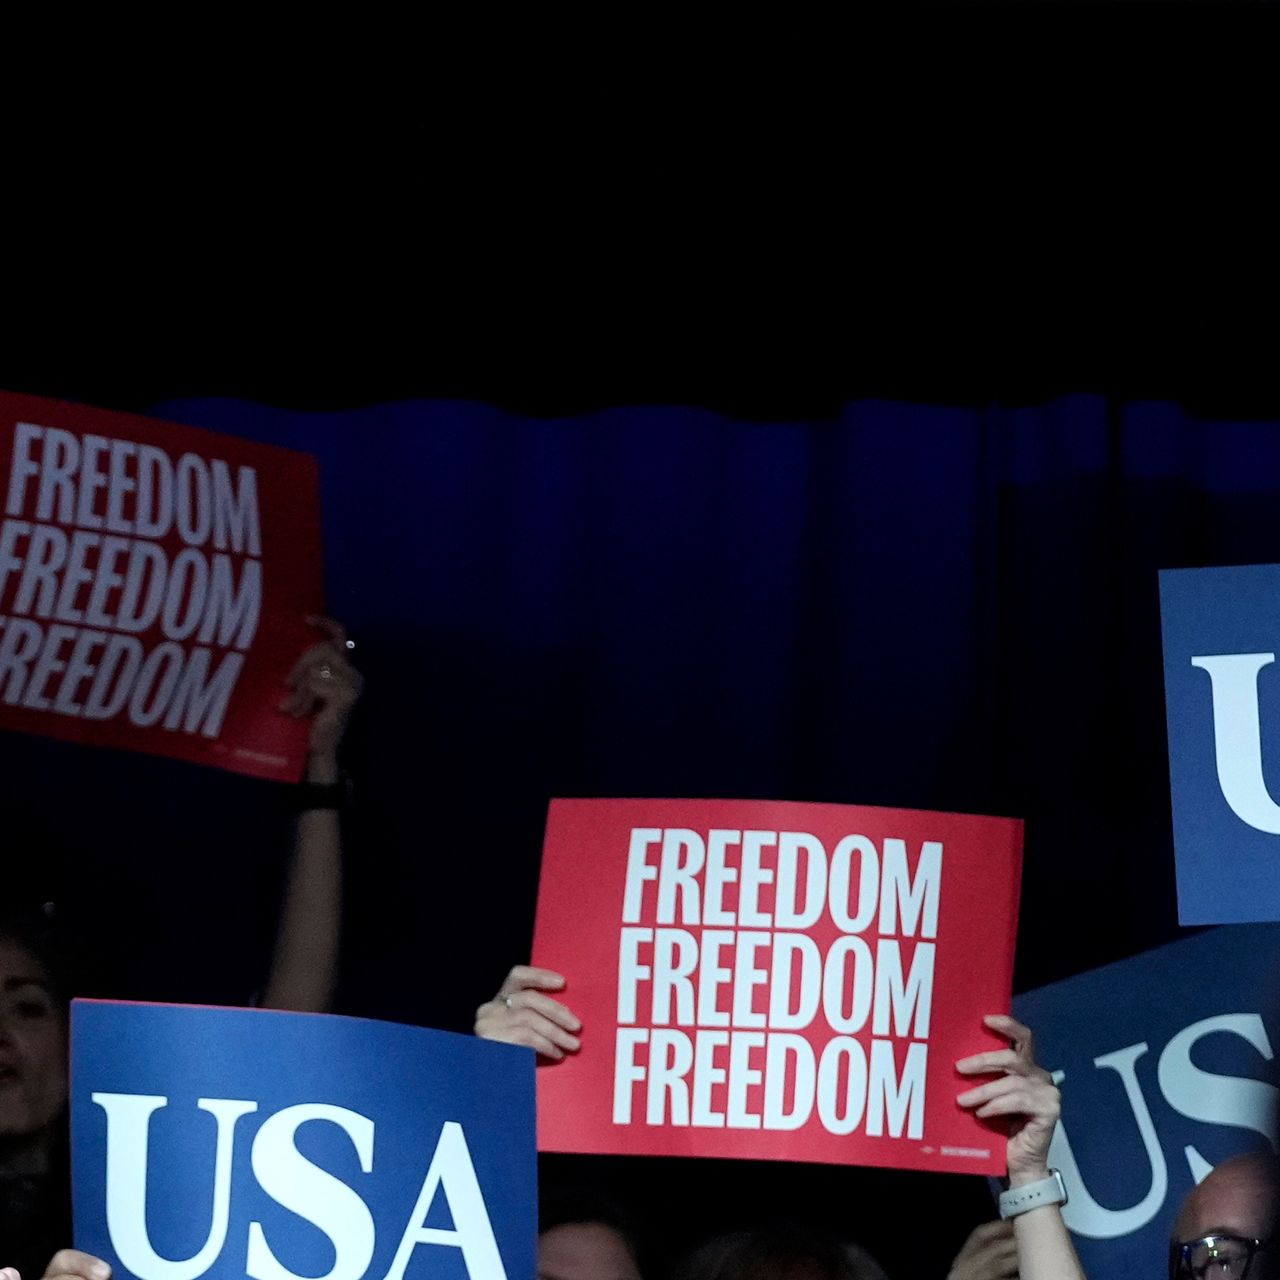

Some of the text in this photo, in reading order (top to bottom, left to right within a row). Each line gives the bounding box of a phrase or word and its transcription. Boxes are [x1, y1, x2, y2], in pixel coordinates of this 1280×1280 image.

[6, 421, 262, 557] FREEDOM
[621, 826, 944, 939] FREEDOM
[615, 926, 937, 1039] FREEDOM
[612, 1026, 929, 1140] FREEDOM
